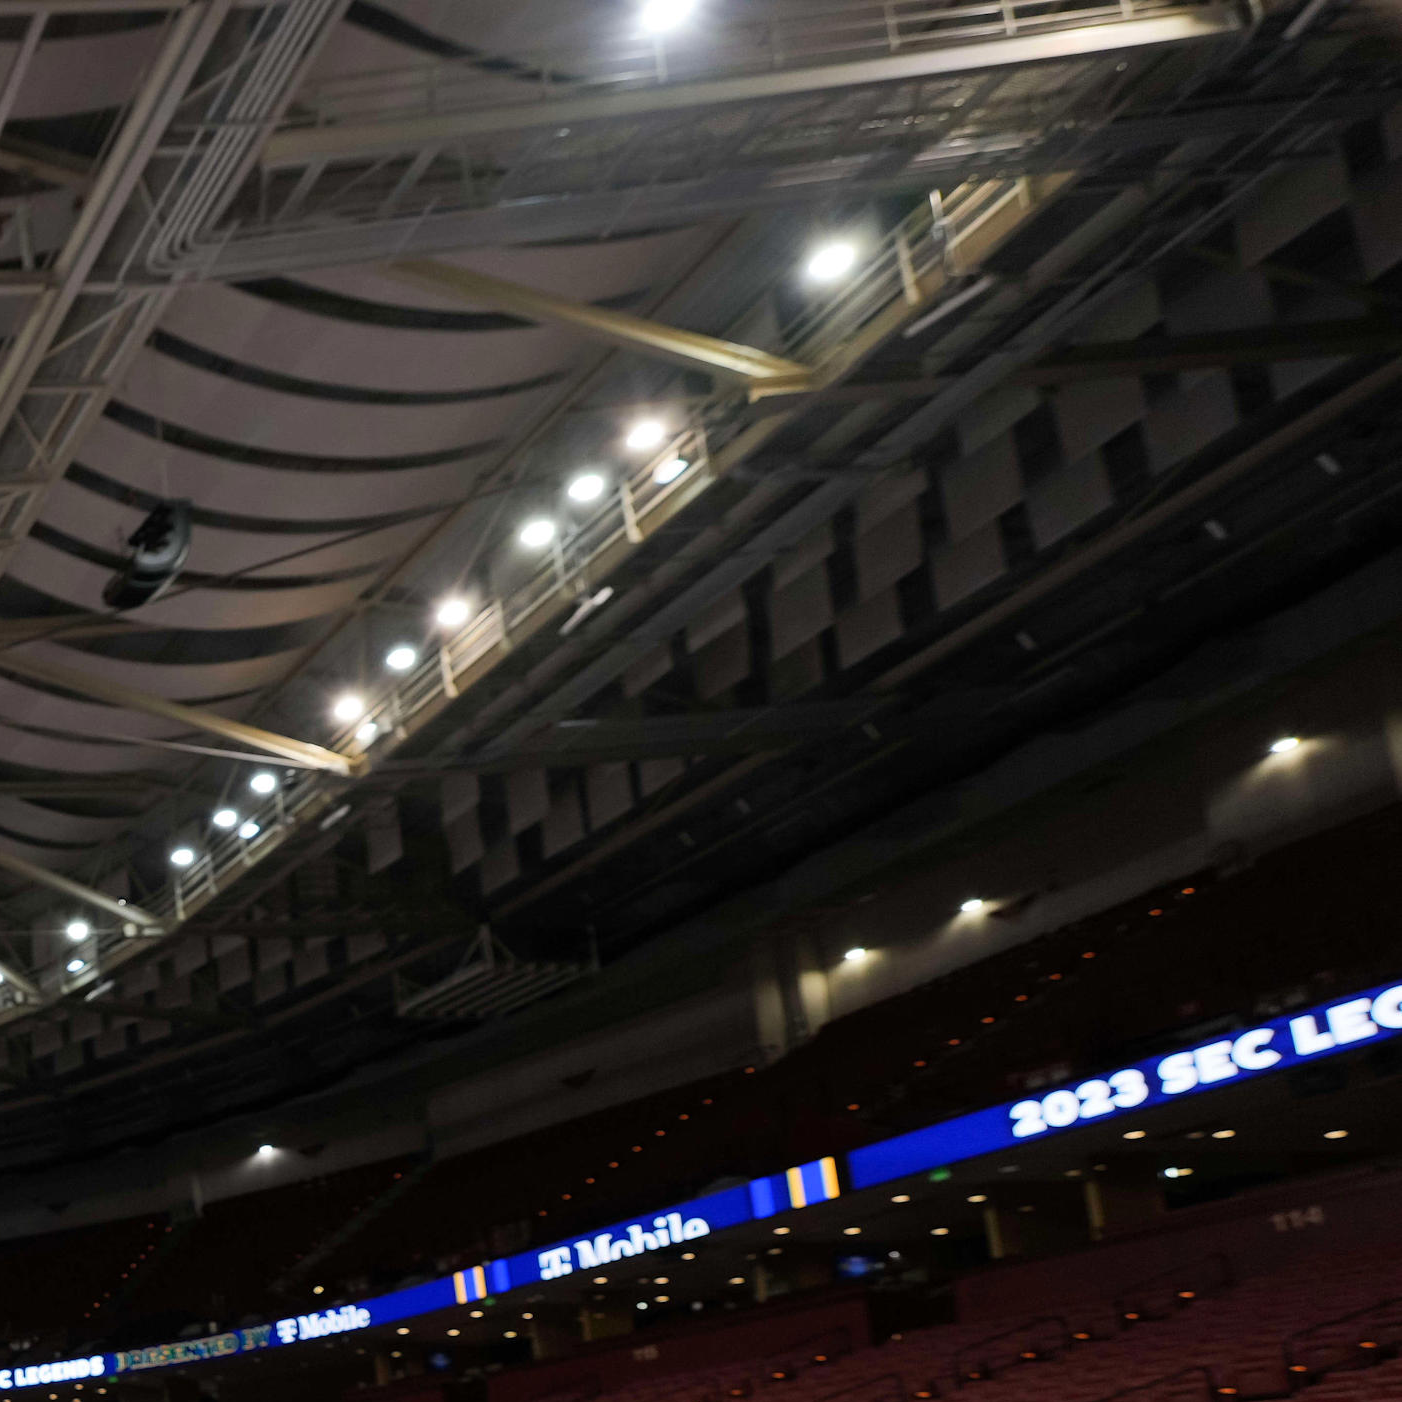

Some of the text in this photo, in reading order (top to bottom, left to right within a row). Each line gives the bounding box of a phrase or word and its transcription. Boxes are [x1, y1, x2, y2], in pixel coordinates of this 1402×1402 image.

[1008, 1067, 1150, 1139] 2023
[1157, 1026, 1283, 1096] SEC
[13, 1354, 106, 1388] LEGENDS
[297, 1304, 371, 1341] Mobile
